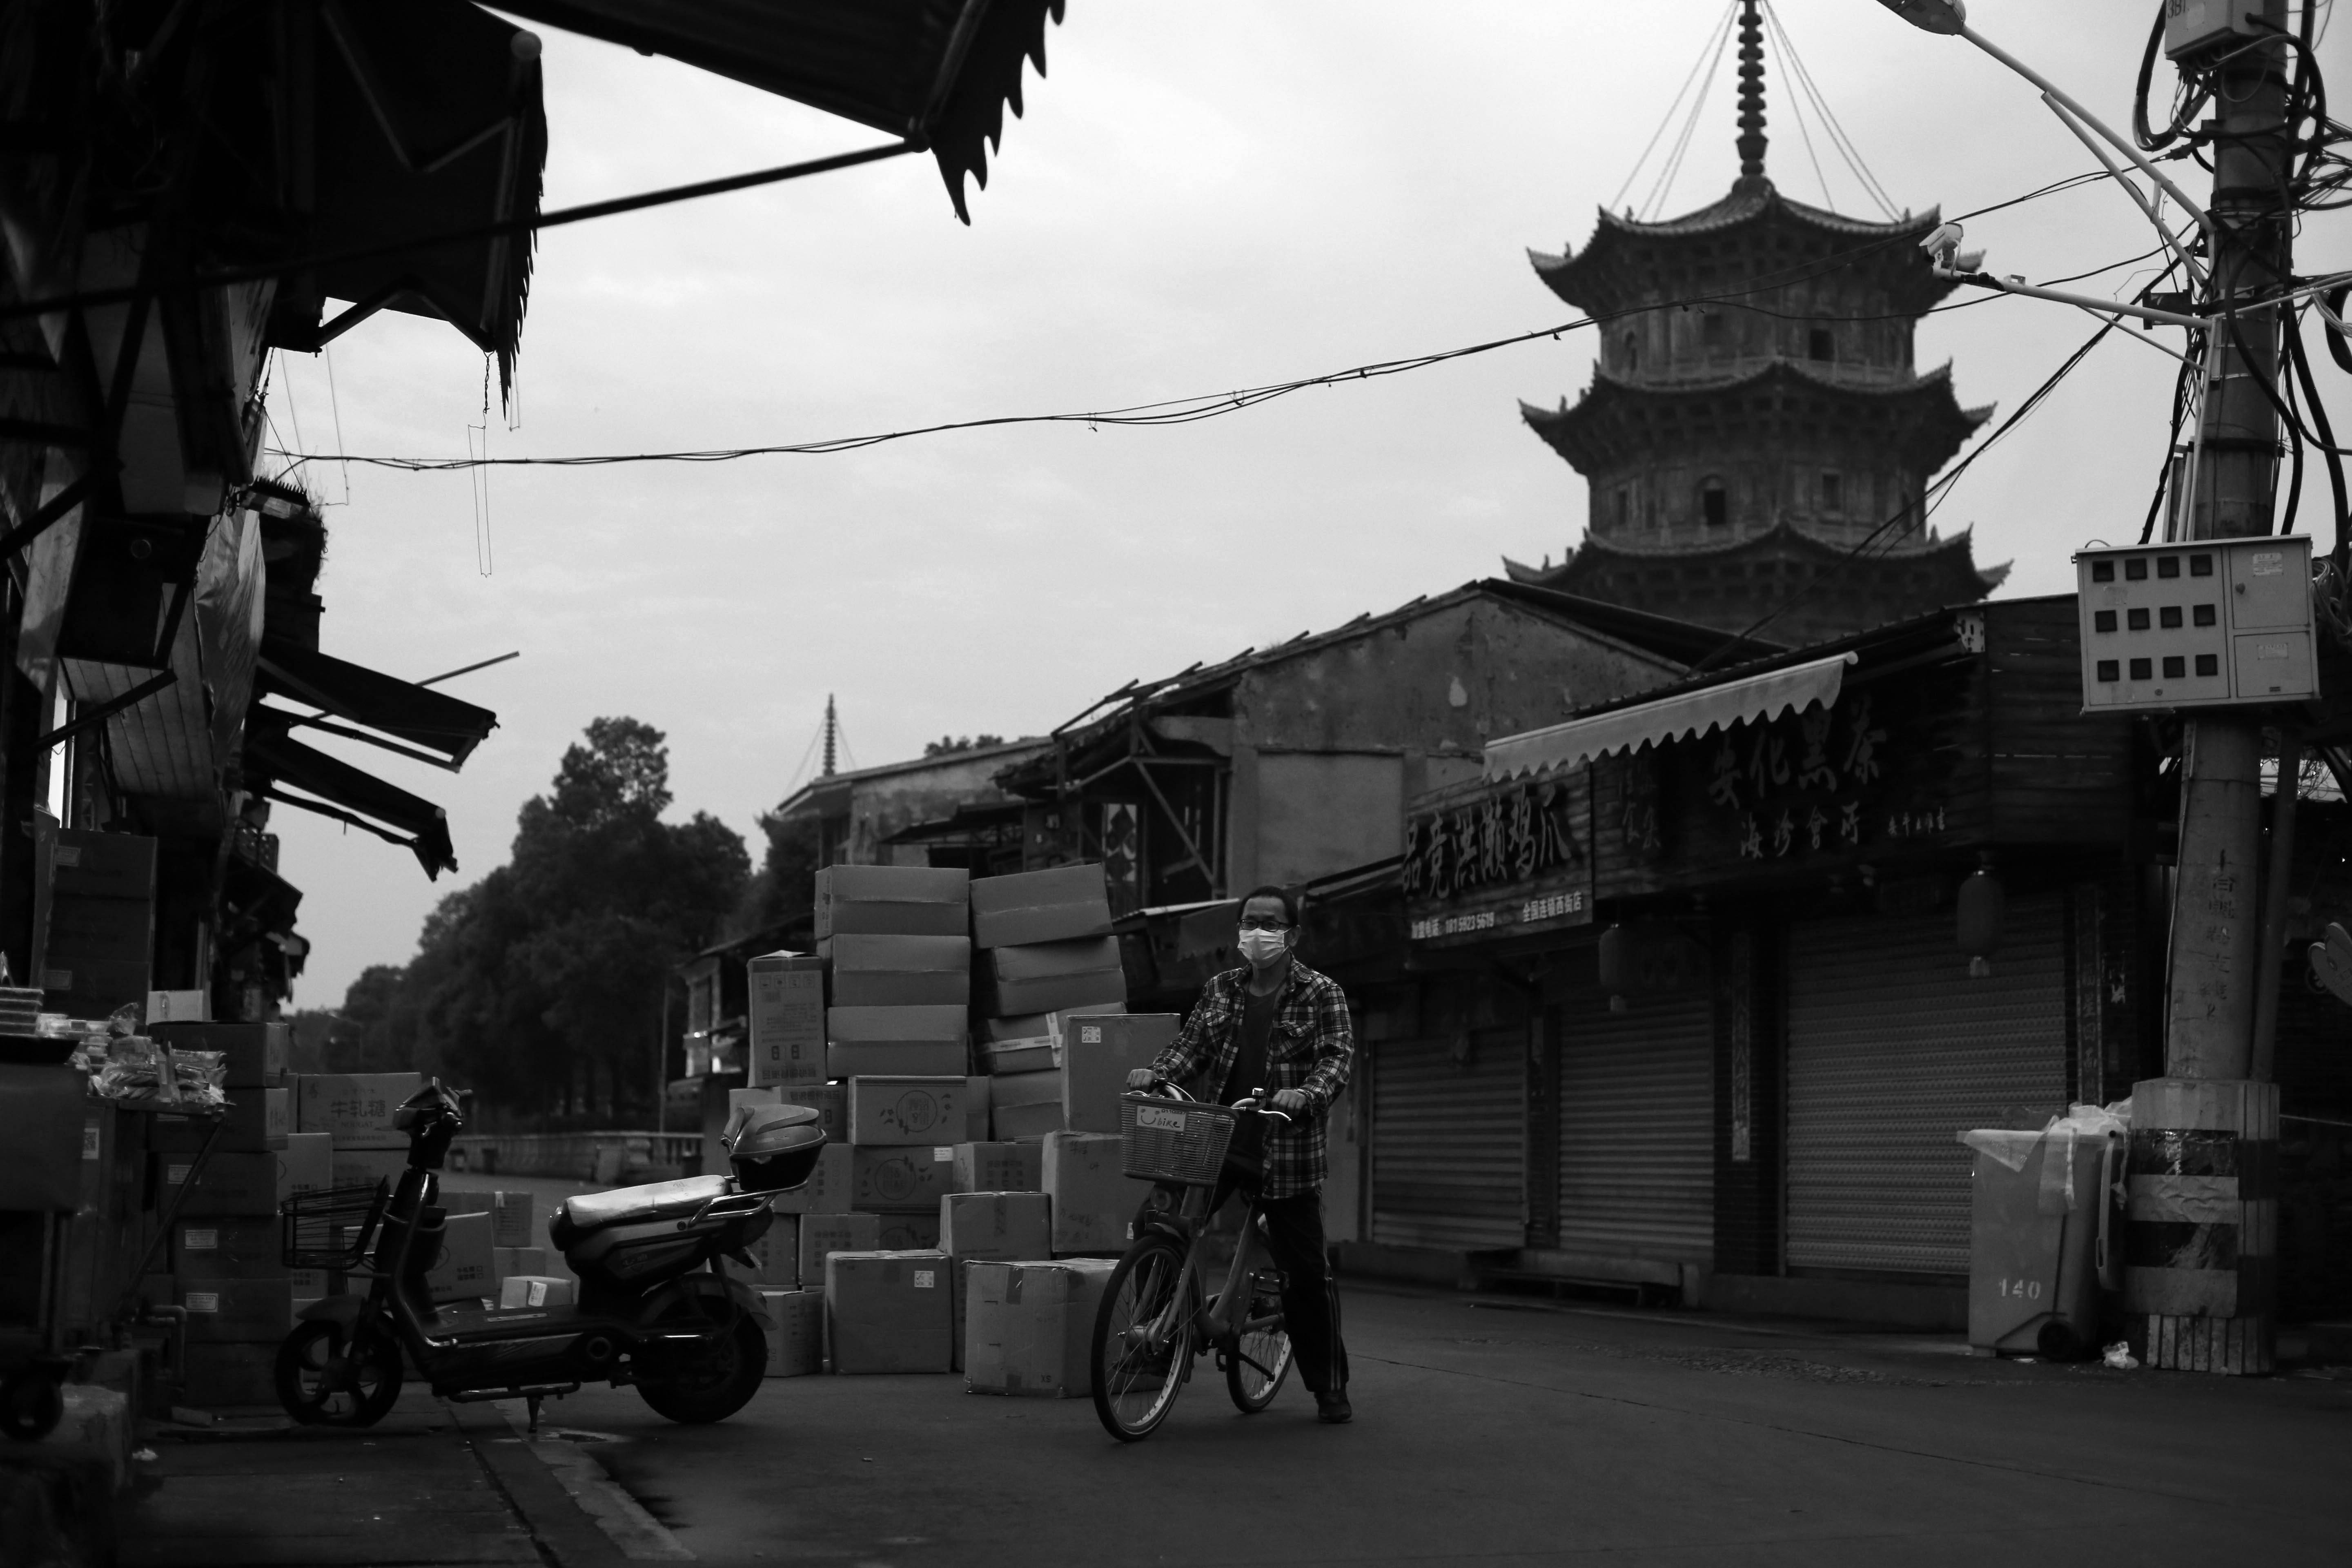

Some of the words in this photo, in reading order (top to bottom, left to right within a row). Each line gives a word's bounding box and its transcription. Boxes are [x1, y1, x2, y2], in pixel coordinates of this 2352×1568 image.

[1708, 693, 1886, 809] 安化黑茶
[330, 1100, 385, 1118] 牛轧糖
[1999, 1278, 2042, 1300] 140
